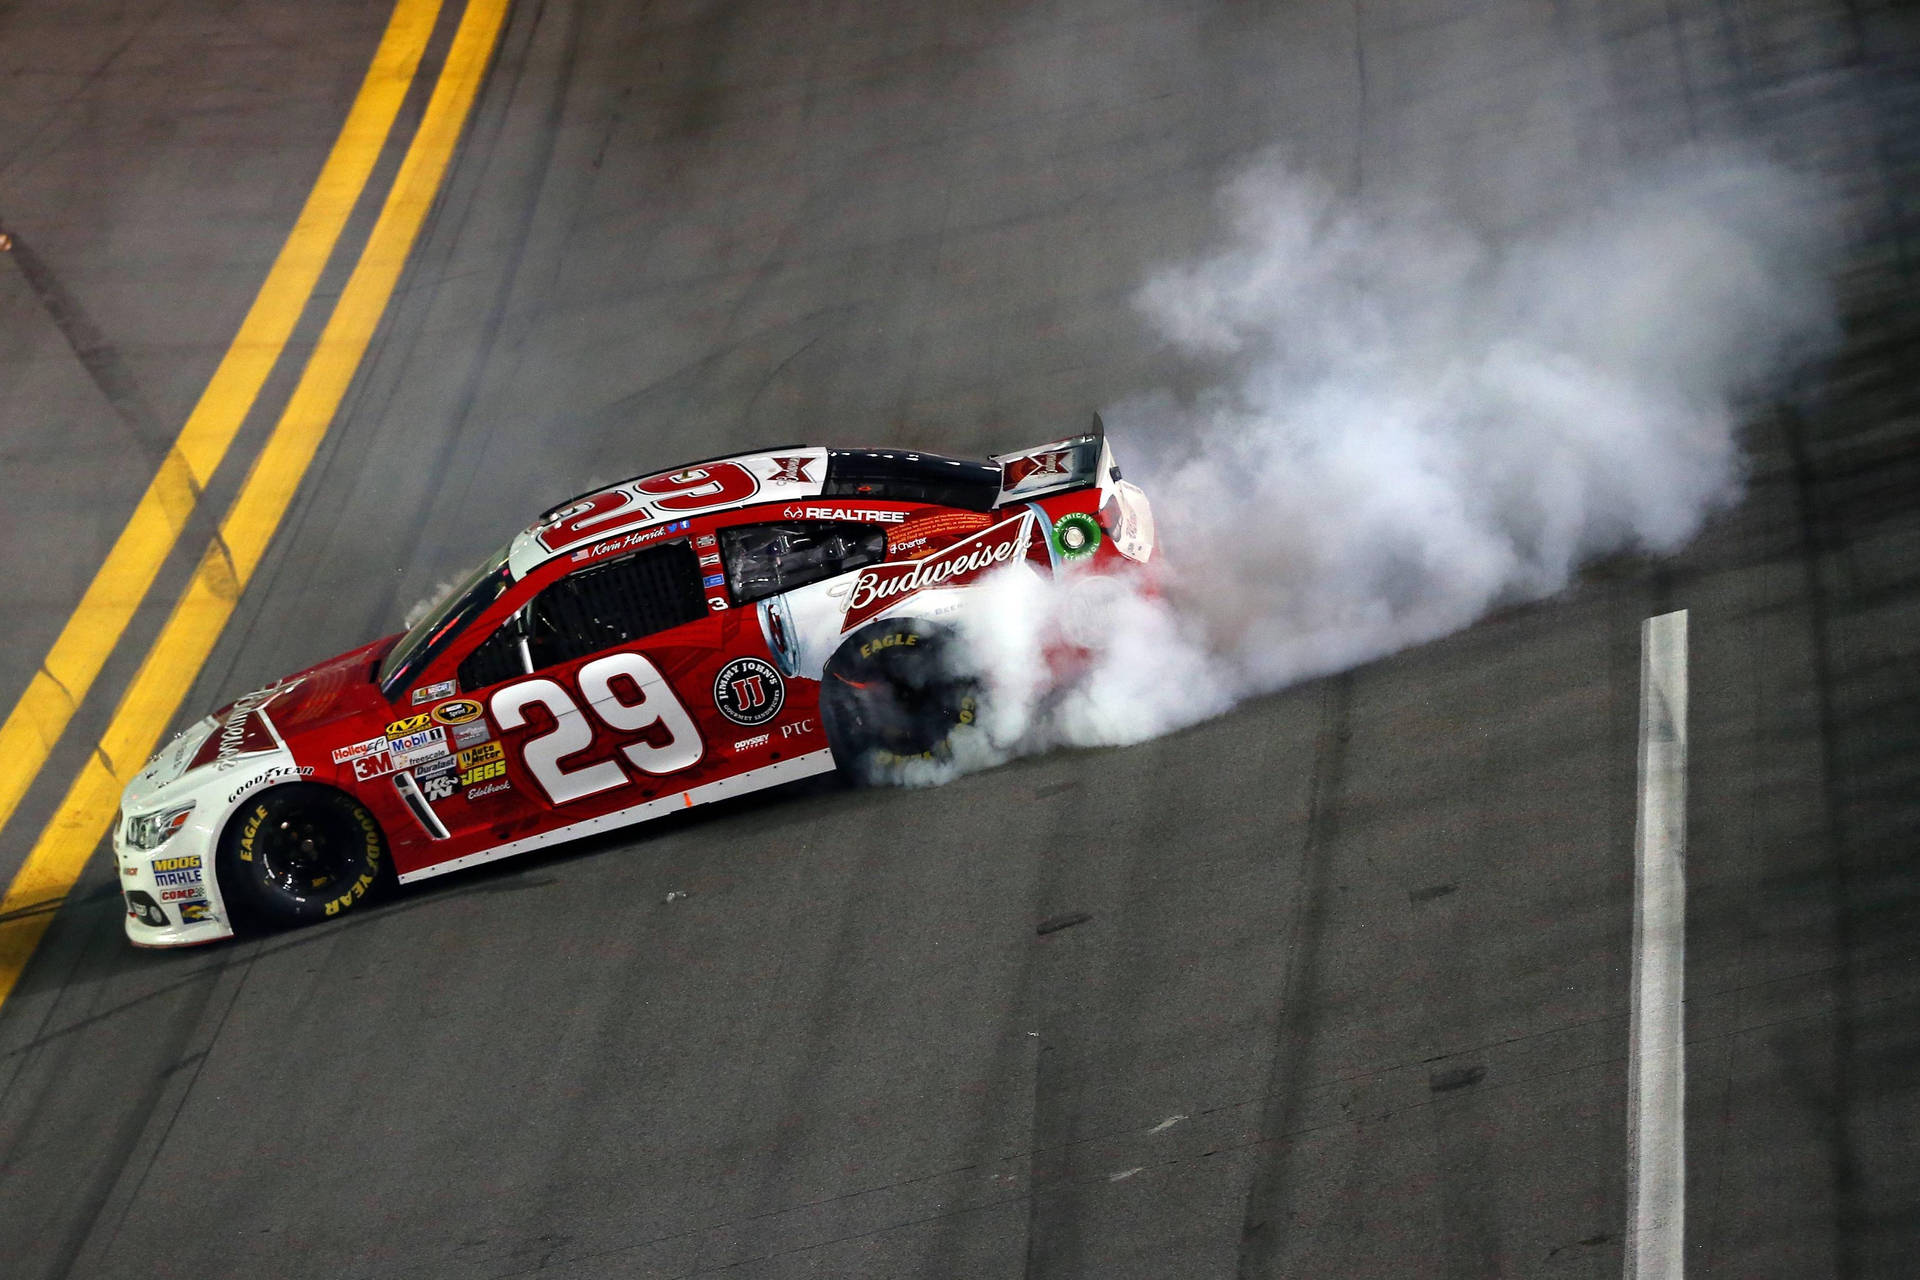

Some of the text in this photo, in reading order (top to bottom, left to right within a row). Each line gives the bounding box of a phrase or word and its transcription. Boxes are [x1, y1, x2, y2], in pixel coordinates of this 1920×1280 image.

[806, 507, 905, 523] REALTREE
[1053, 512, 1093, 532] AMERICAN
[591, 526, 665, 557] Kevin Harvick
[898, 537, 927, 551] Charter
[826, 534, 1033, 614] Budweiser
[708, 597, 728, 611] 3
[860, 634, 919, 659] EAGLE
[719, 662, 778, 700] JIMMY JOHN'S
[731, 675, 766, 711] JJ
[724, 704, 752, 721] GOURMET
[491, 652, 704, 805] 29
[781, 720, 814, 739] PTC
[392, 733, 428, 752] Mobil
[734, 733, 769, 749] ODYSSEY
[334, 744, 367, 760] Holley
[409, 749, 446, 765] freescale
[472, 745, 494, 757] Auto
[356, 751, 393, 778] 3M
[417, 757, 454, 776] Duralast
[461, 760, 506, 786] JEGS
[228, 766, 314, 803] GOODYEAR
[424, 776, 458, 801] K&N
[467, 780, 511, 800] Edelbrock
[240, 804, 269, 862] EAGLE
[154, 855, 200, 872] MOOG
[155, 870, 202, 887] MAHLE
[162, 888, 195, 900] COMP
